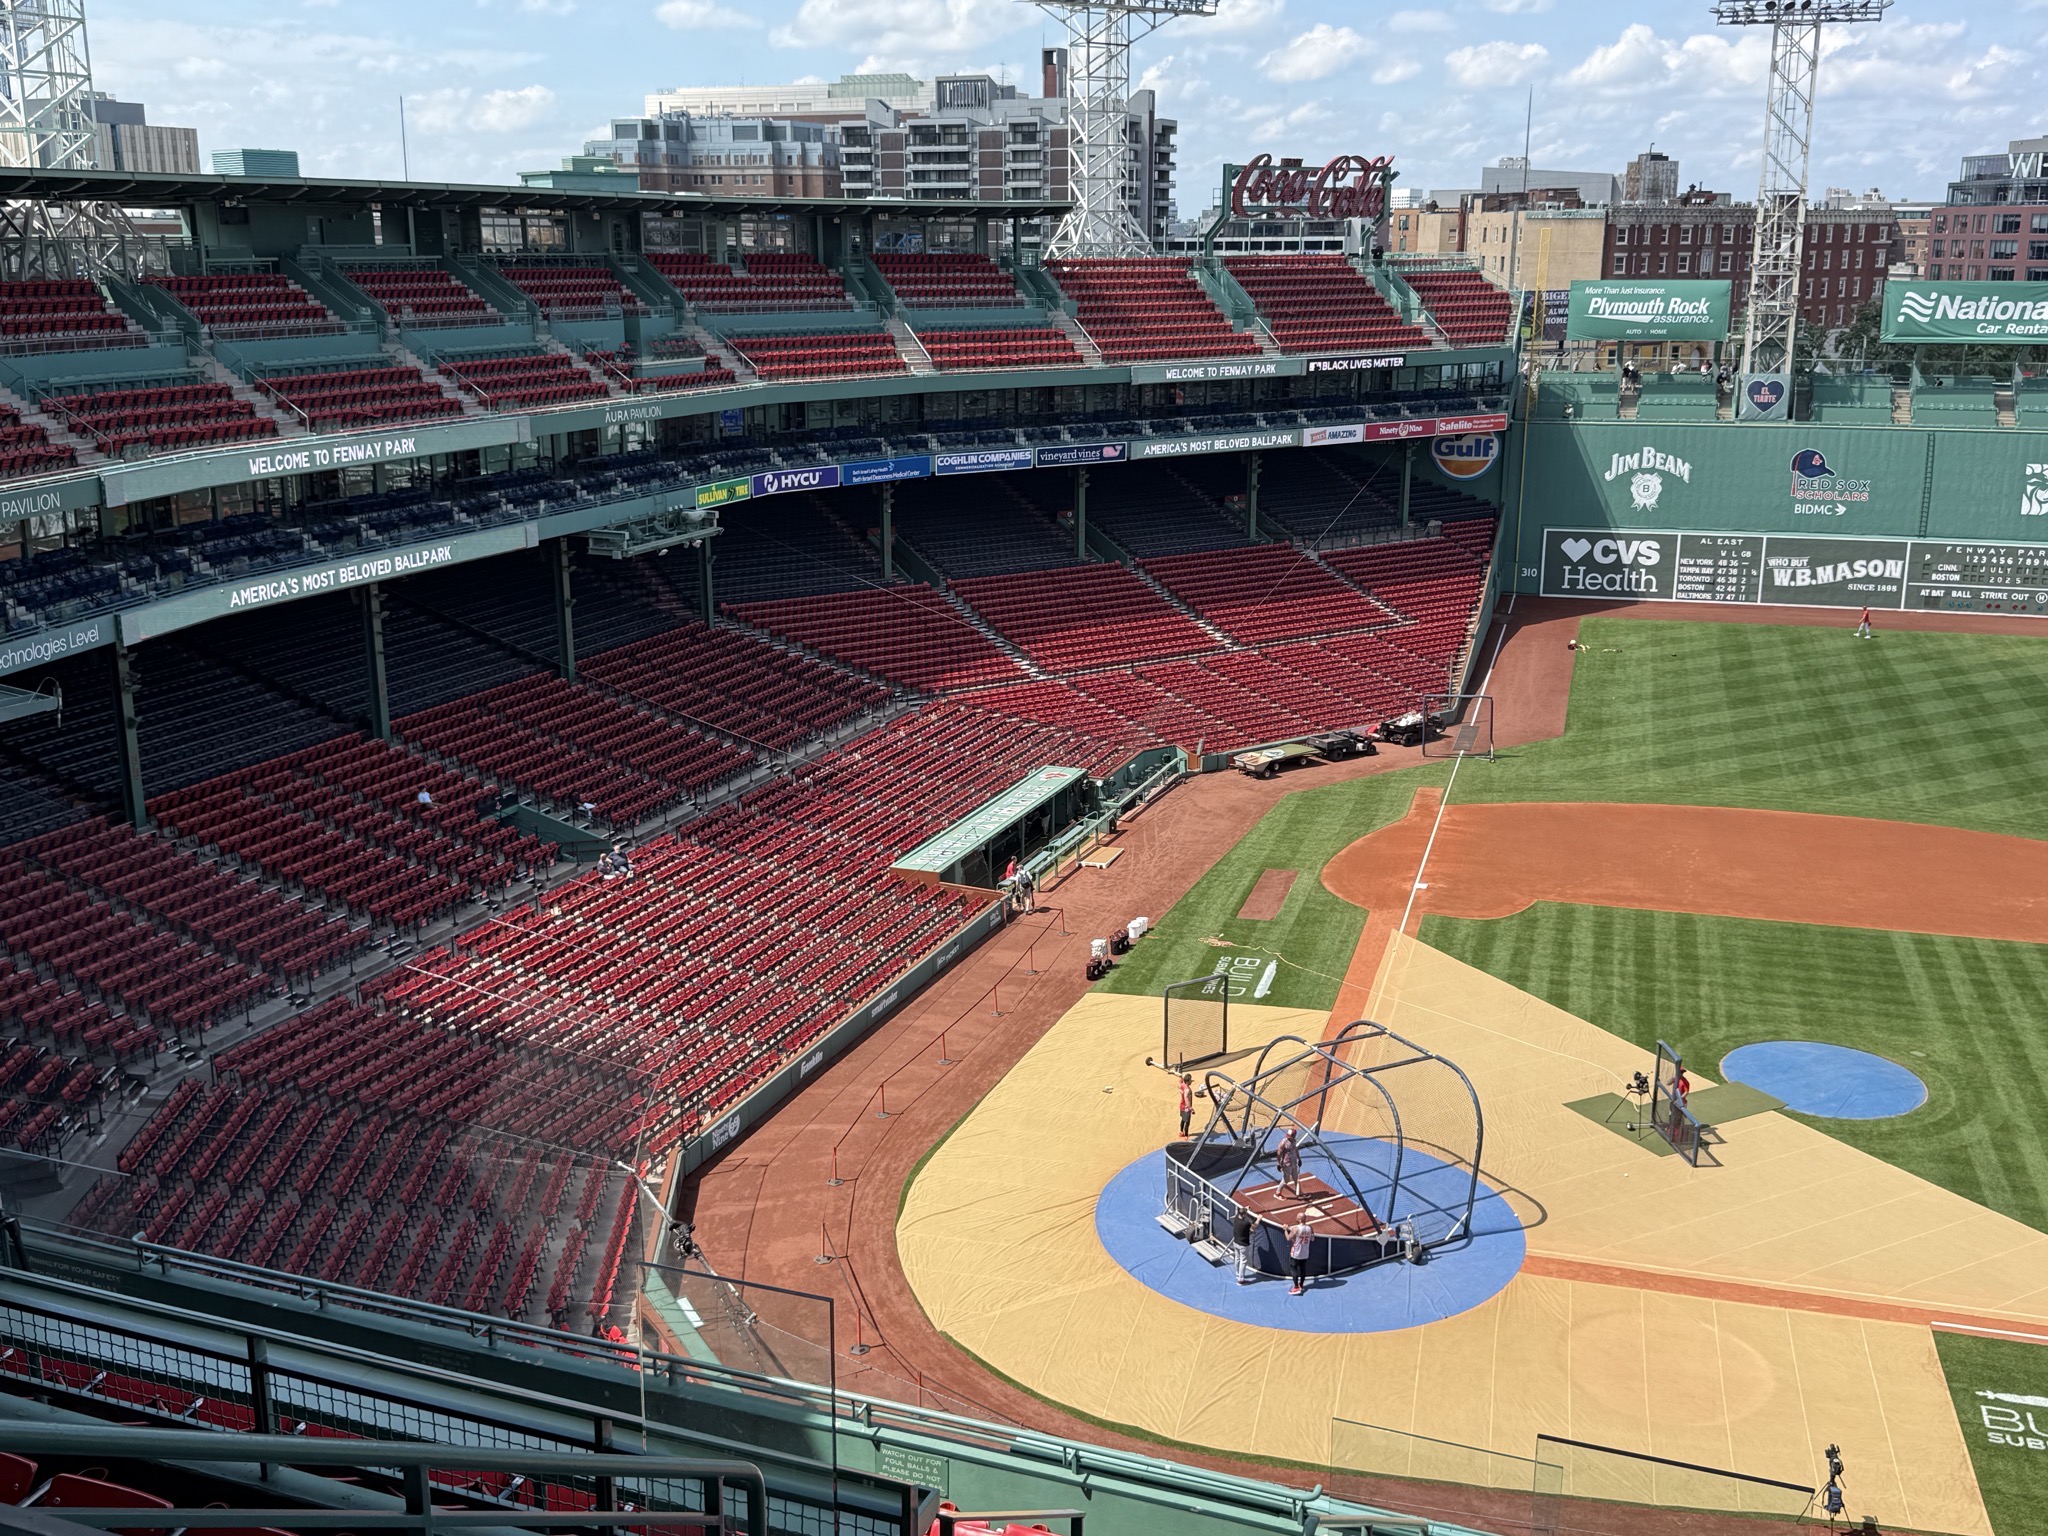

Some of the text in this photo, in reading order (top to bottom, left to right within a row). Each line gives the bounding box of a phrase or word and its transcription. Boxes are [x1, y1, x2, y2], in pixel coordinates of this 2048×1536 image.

[1232, 153, 1395, 218] Coca-Cola
[1584, 286, 1666, 295] More Than Just Insurance.
[1587, 297, 1710, 316] Plymouth Rock
[1653, 314, 1709, 324] assurance
[1976, 323, 2002, 334] Car
[1322, 357, 1404, 371] BLACK LIVES MATTER
[1166, 364, 1276, 380] WELCOME TO FENWAY PARK
[1761, 386, 1770, 394] EL
[630, 406, 662, 420] PAVILION
[1379, 426, 1399, 436] Ninety
[1408, 424, 1423, 432] Nine
[1439, 420, 1473, 432] Safelite
[1326, 429, 1357, 440] AMAZING
[1144, 434, 1292, 456] AMERICA'S MOST BELOVED BALLPARK
[1434, 437, 1494, 458] Gulf
[249, 438, 416, 475] WELCOME TO FENWAY PARK
[938, 452, 1032, 466] COGHLIN COMPANIES
[1040, 450, 1077, 462] vineyard
[1078, 449, 1099, 458] vines
[1604, 446, 1692, 484] JIM BEAM
[782, 472, 820, 489] HYCU
[1643, 484, 1650, 492] B
[1798, 478, 1871, 492] RED SOX
[698, 484, 748, 505] SULLIVAN TIRE
[1796, 490, 1869, 502] SCHOLARS
[2, 492, 61, 518] PAVILION
[1794, 504, 1832, 516] BIDMC
[1593, 538, 1661, 566] CVS
[1946, 546, 2006, 555] FENWAY
[1767, 558, 1808, 567] WHO BUT
[230, 546, 452, 608] AMERICA'S MOST BELOVED BALLPARK
[1521, 568, 1538, 578] 310
[1561, 566, 1658, 592] Health
[1773, 559, 1904, 586] W.B.MASON
[1980, 591, 2008, 600] STRIKE
[0, 624, 99, 670] chnologies Level
[1219, 956, 1261, 996] BUILD
[872, 990, 898, 1018] smartwater
[712, 1122, 729, 1140] Ninety
[712, 1131, 729, 1150] Nine
[1300, 1236, 1309, 1245] 75
[54, 1262, 70, 1271] FOR
[71, 1266, 91, 1275] YOUR
[92, 1270, 120, 1281] SAFETY
[1988, 1432, 2048, 1450] SUB
[881, 1448, 941, 1467] WATCH OUT FOR
[885, 1457, 904, 1467] FOUL
[907, 1463, 930, 1472] BALLS
[882, 1465, 910, 1476] PLEASE
